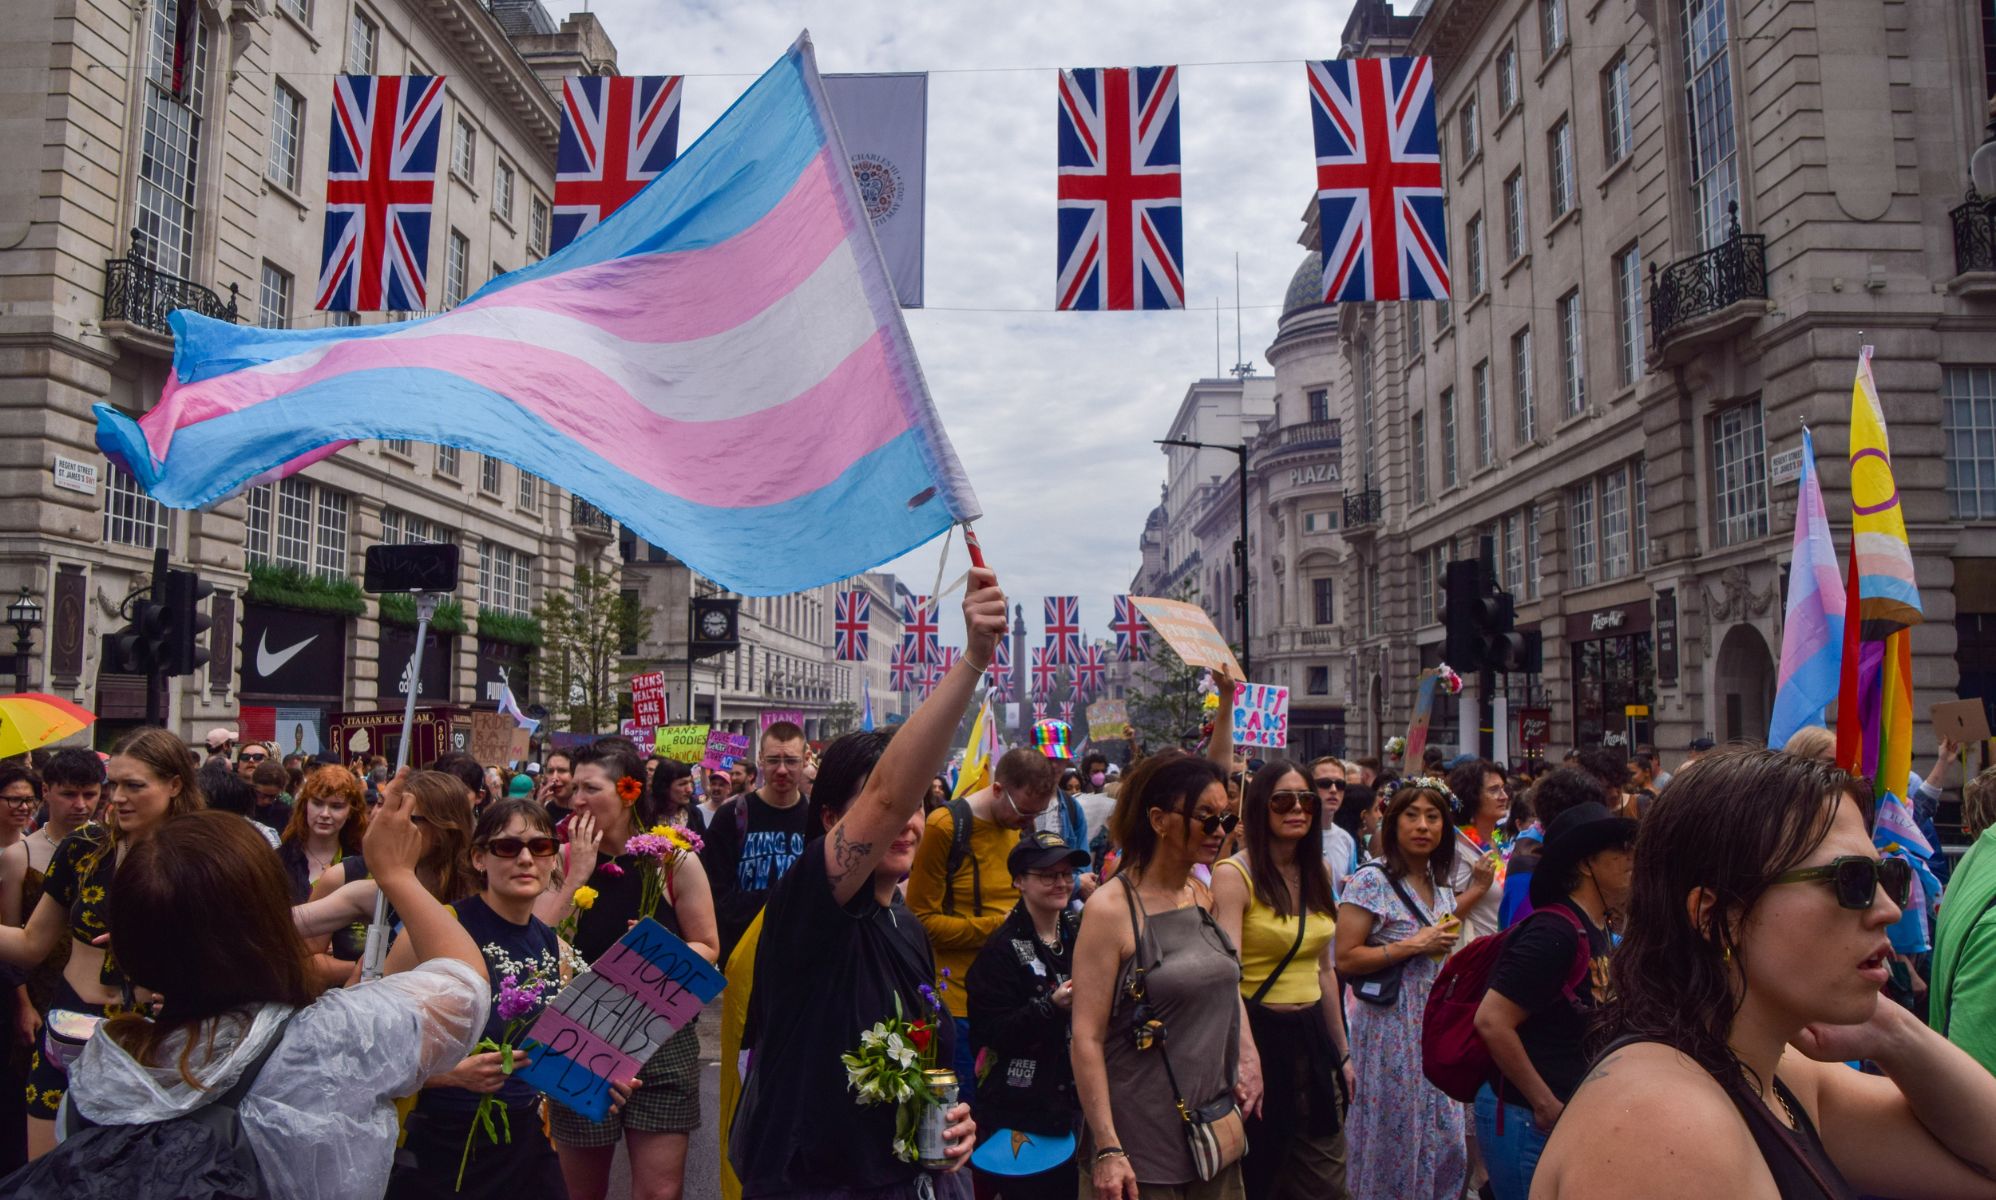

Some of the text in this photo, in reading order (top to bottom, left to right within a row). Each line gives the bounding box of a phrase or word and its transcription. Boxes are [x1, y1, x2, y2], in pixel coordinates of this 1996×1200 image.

[59, 460, 94, 476] REGENT STREET
[1289, 463, 1340, 485] PLAZA
[85, 475, 96, 485] SW1
[399, 681, 423, 694] ads
[632, 674, 662, 689] TRANS
[632, 687, 664, 702] HEALTH
[1233, 682, 1287, 715] PLIFT
[637, 701, 660, 713] CARE
[347, 713, 430, 725] ITALIAN ICE CAM
[474, 712, 511, 730] PRIDE
[640, 714, 660, 726] NOW
[765, 714, 800, 723] TRANS
[1233, 708, 1286, 731] RANS
[661, 726, 698, 735] TRANS
[672, 735, 708, 745] BODIES
[1232, 731, 1285, 747] VOICES
[742, 832, 805, 858] KING O
[775, 855, 797, 880] YO
[614, 931, 708, 1007] MORE
[561, 967, 671, 1056] TRANS
[1010, 1058, 1037, 1069] FREE
[1007, 1067, 1035, 1078] HUG!
